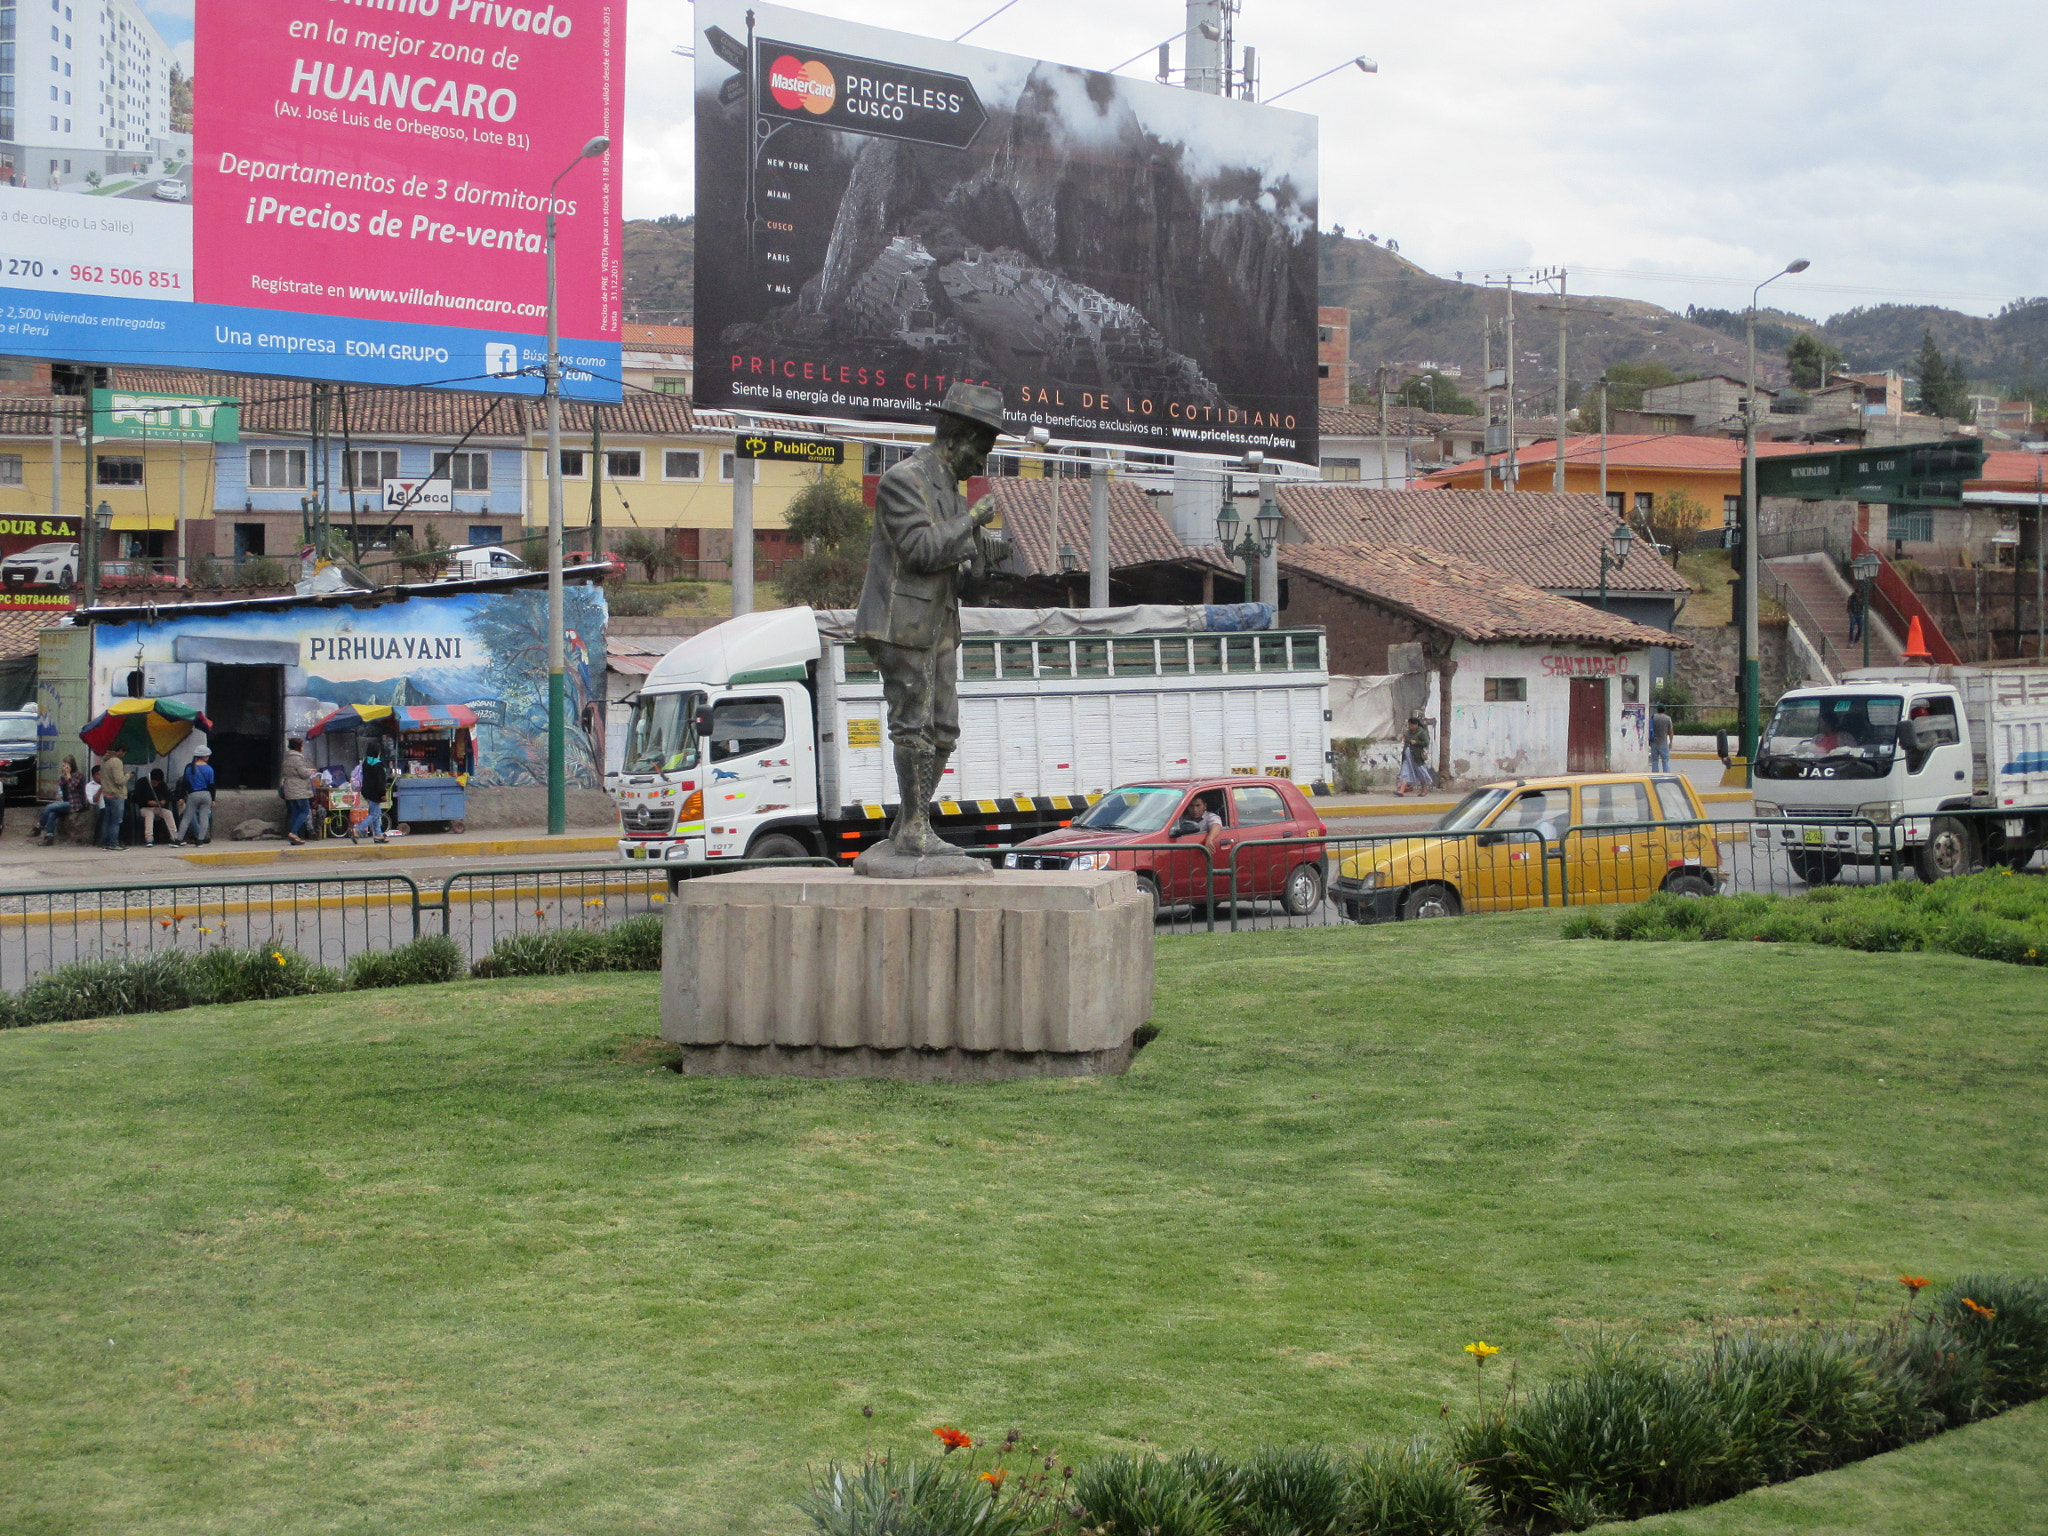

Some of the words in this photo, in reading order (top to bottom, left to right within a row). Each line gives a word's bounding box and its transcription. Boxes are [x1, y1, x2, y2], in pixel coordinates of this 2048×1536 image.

[449, 0, 572, 38] Privado
[603, 7, 611, 48] 06.06.2015
[289, 20, 319, 39] en
[326, 19, 348, 45] la
[355, 31, 425, 58] mejor
[429, 41, 485, 65] zona
[491, 46, 519, 70] de
[603, 49, 610, 57] el
[291, 59, 517, 123] HUANCARO
[602, 82, 610, 105] válido
[771, 73, 834, 98] MasterCard
[846, 98, 904, 121] CUSCO
[275, 100, 301, 118] (Av.
[306, 105, 338, 123] José
[342, 110, 370, 127] Luis
[374, 115, 391, 130] de
[396, 118, 468, 142] Orbegoso,
[473, 128, 503, 144] Lote
[507, 132, 530, 151] B1)
[767, 158, 785, 168] NEW
[788, 161, 809, 172] YORK
[219, 152, 396, 194] Departamentos
[402, 174, 428, 197] de
[434, 179, 448, 199] 3
[454, 181, 577, 216] dormitorios
[602, 183, 609, 194] de
[767, 189, 791, 200] MIAMI
[602, 194, 610, 216] stock
[13, 211, 29, 223] de
[32, 213, 80, 230] colegio
[83, 218, 97, 230] La
[101, 219, 134, 236] Salle)
[246, 197, 361, 233] ¡Precios
[369, 209, 402, 238] de
[602, 216, 608, 228] un
[767, 221, 793, 231] CUSCO
[602, 228, 610, 246] para
[601, 247, 609, 272] VENTA
[767, 252, 790, 263] PARIS
[8, 259, 43, 277] 270
[70, 265, 104, 283] 962
[110, 268, 143, 286] 506
[149, 271, 181, 289] 851
[252, 275, 323, 295] Regístrate
[328, 285, 344, 297] en
[349, 286, 549, 317] www.villahuancaro.com
[601, 291, 608, 302] de
[775, 283, 791, 294] MÁS
[7, 307, 41, 320] 2,500
[44, 310, 98, 326] viviendas
[101, 316, 166, 331] entregadas
[601, 303, 609, 331] Precios
[610, 311, 618, 331] hasta
[9, 323, 20, 333] el
[23, 323, 50, 336] Perú
[216, 325, 252, 345] Una
[258, 333, 335, 353] empresa
[346, 340, 385, 358] EOM
[389, 344, 449, 363] GRUPO
[576, 356, 606, 367] como
[731, 355, 886, 386] PRICELESS
[1021, 386, 1064, 405] SAL
[1083, 393, 1110, 409] DE
[1127, 397, 1153, 414] LO
[1170, 402, 1296, 430] COTIDIANO
[732, 382, 769, 397] Siente
[772, 385, 782, 398] la
[832, 391, 846, 404] de
[850, 397, 869, 407] una
[873, 397, 921, 411] maravilla
[1030, 411, 1042, 423] de
[1046, 413, 1096, 429] beneficios
[1100, 419, 1148, 434] exclusivos
[1151, 426, 1162, 436] en
[1172, 427, 1296, 449] www.priceless.com/peru
[131, 429, 204, 438] PUBLICIDAD
[774, 441, 835, 456] PubliCom
[1791, 465, 1829, 478] MUNICIPALIDAD
[1859, 463, 1869, 473] DEL
[1877, 460, 1895, 470] CUSCO
[41, 521, 76, 536] S.A.
[14, 594, 70, 605] 987844446
[310, 637, 461, 660] PIRHUAYANI
[1799, 767, 1835, 778] JAC
